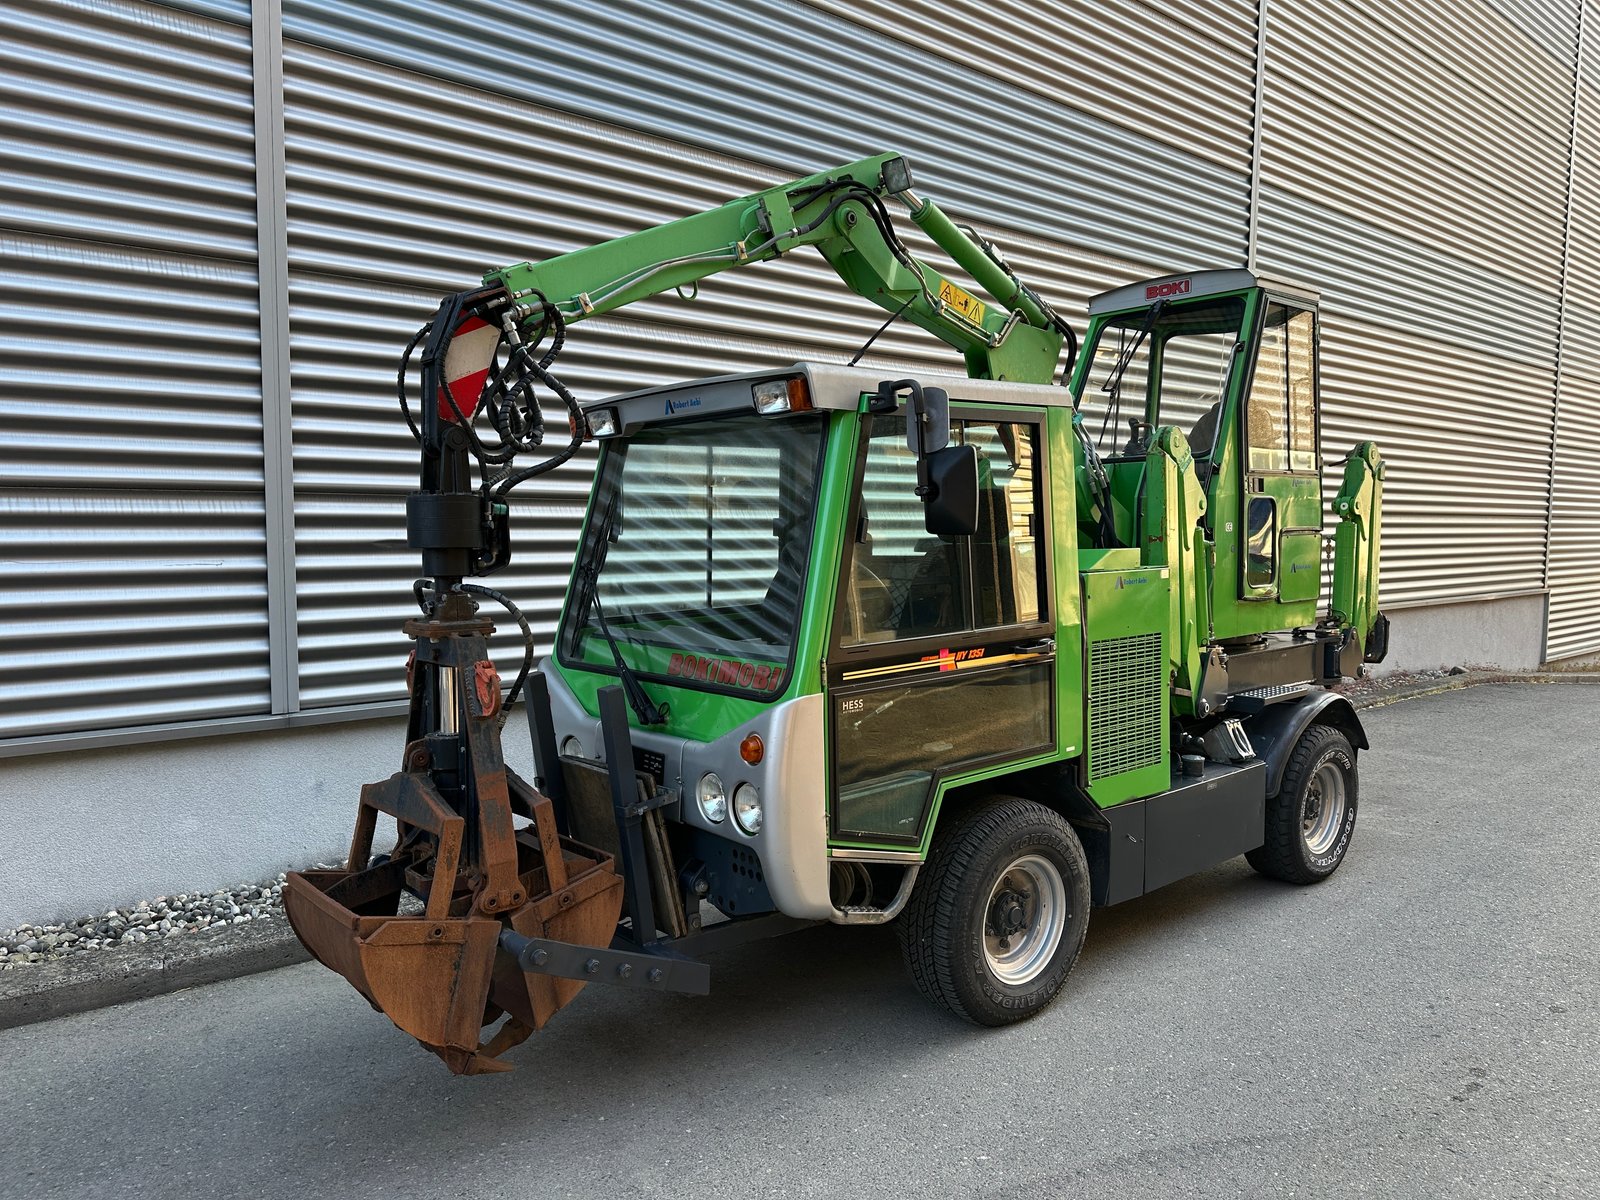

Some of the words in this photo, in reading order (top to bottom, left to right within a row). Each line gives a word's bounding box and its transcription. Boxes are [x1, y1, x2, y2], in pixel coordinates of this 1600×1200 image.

[1146, 280, 1190, 299] BOKI
[955, 650, 969, 661] HY
[842, 698, 864, 711] HESS
